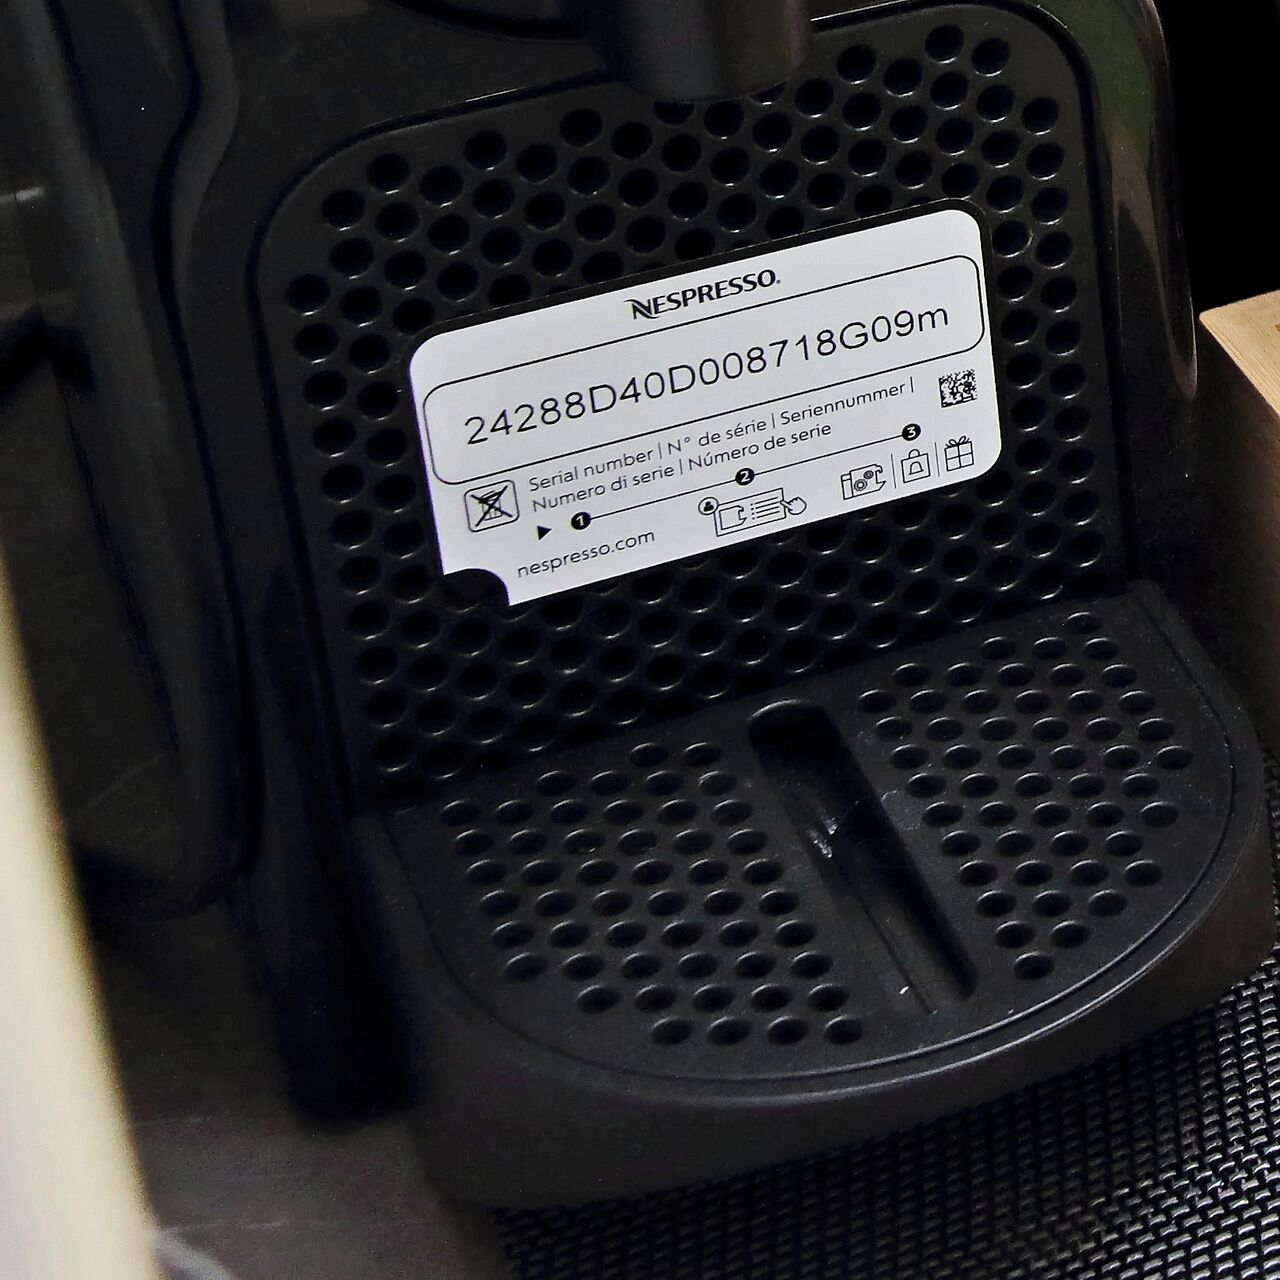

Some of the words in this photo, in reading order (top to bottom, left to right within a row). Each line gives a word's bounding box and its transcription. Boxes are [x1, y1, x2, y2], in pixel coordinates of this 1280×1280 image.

[625, 269, 779, 320] NESPRESSO
[464, 307, 949, 446] 24288D40D008718G09m
[529, 466, 579, 492] Serial
[584, 448, 654, 478] number
[698, 428, 721, 447] de
[725, 417, 767, 441] série
[780, 382, 906, 426] Seriennummer
[532, 480, 606, 513] Numero
[611, 472, 628, 494] di
[632, 463, 675, 488] serie
[688, 443, 760, 471] Número
[764, 431, 786, 451] de
[791, 422, 832, 446] serie
[518, 532, 655, 578] nespresso.com
